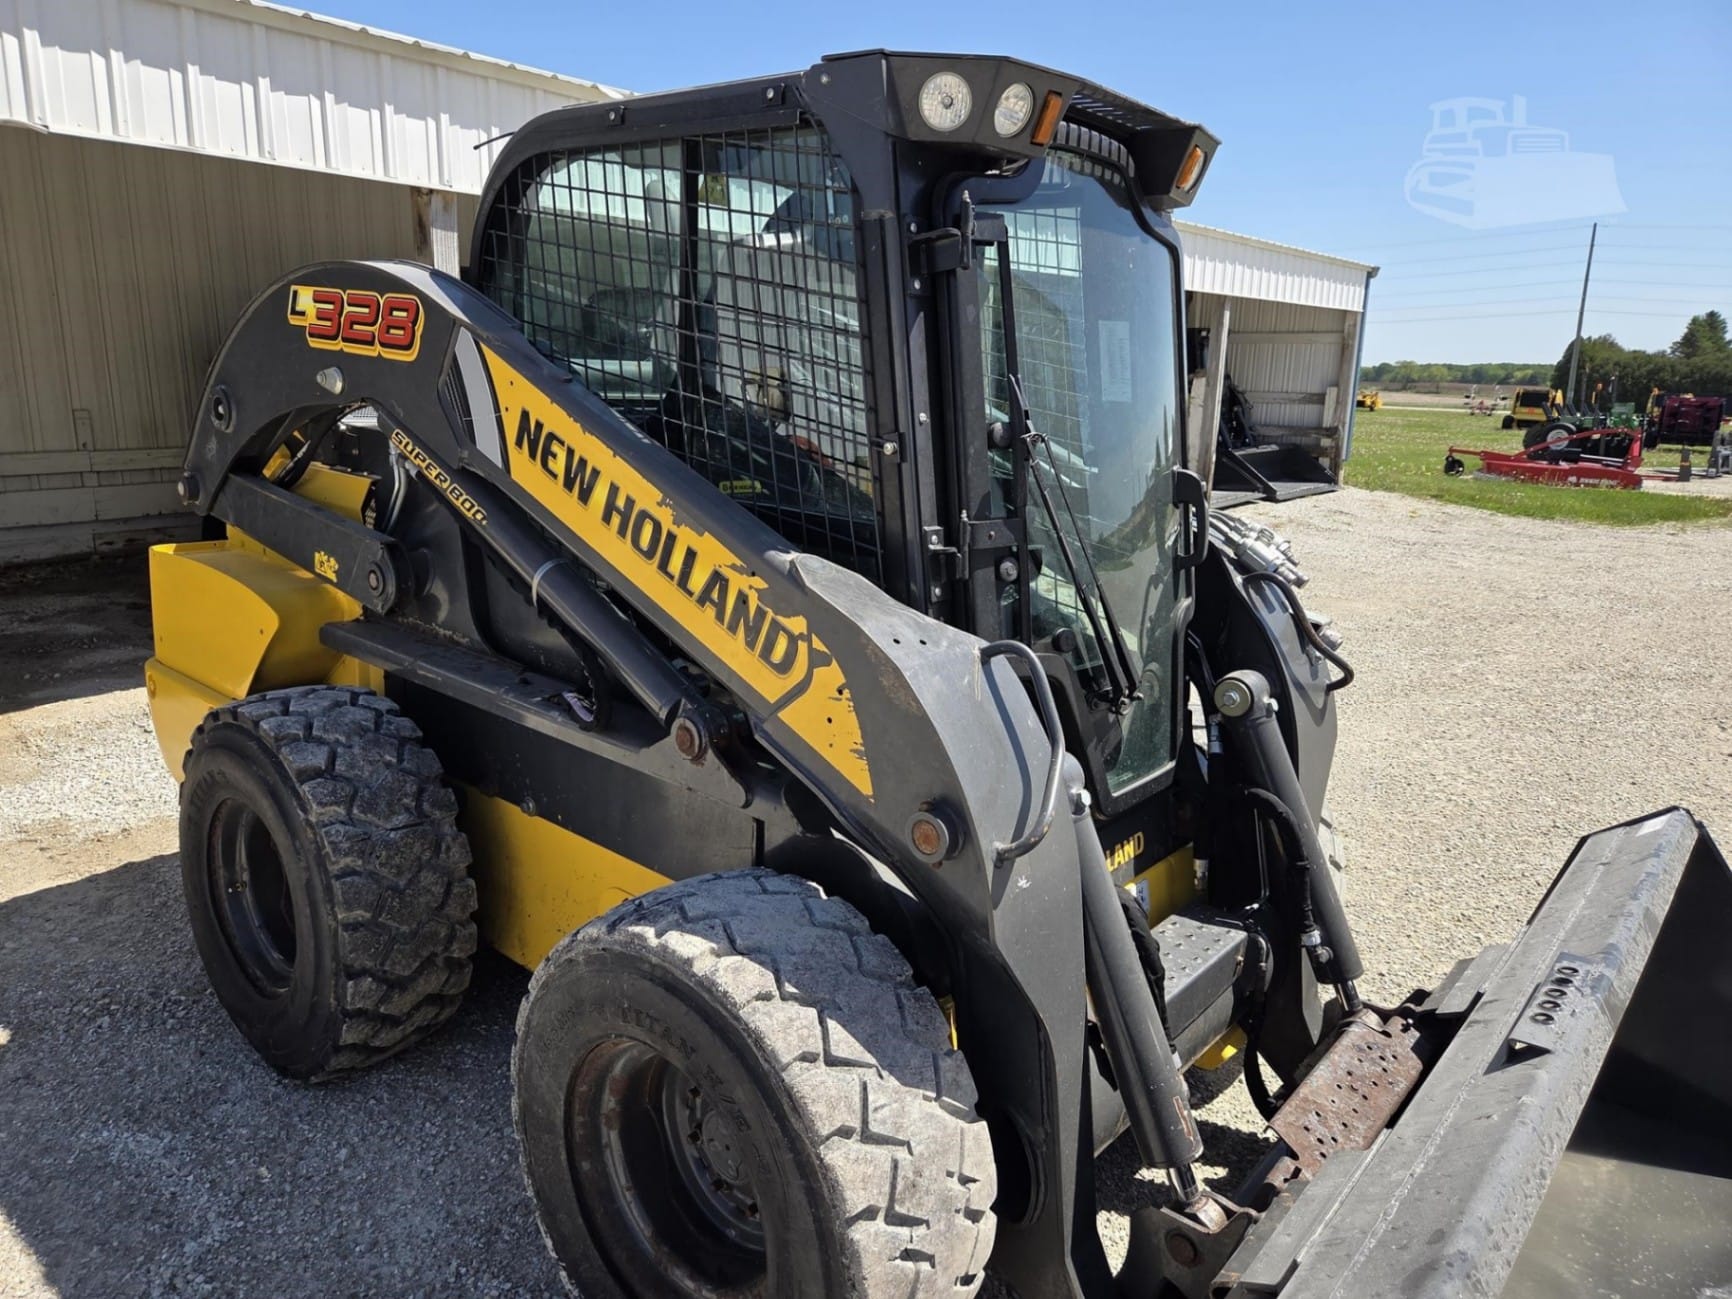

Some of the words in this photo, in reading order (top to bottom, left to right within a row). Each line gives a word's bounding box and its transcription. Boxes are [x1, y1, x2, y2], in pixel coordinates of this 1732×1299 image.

[288, 286, 422, 356] L328
[392, 430, 450, 489] SUPER
[514, 407, 601, 506] NEW
[602, 480, 800, 679] HOLLAND
[1105, 832, 1144, 873] LAND
